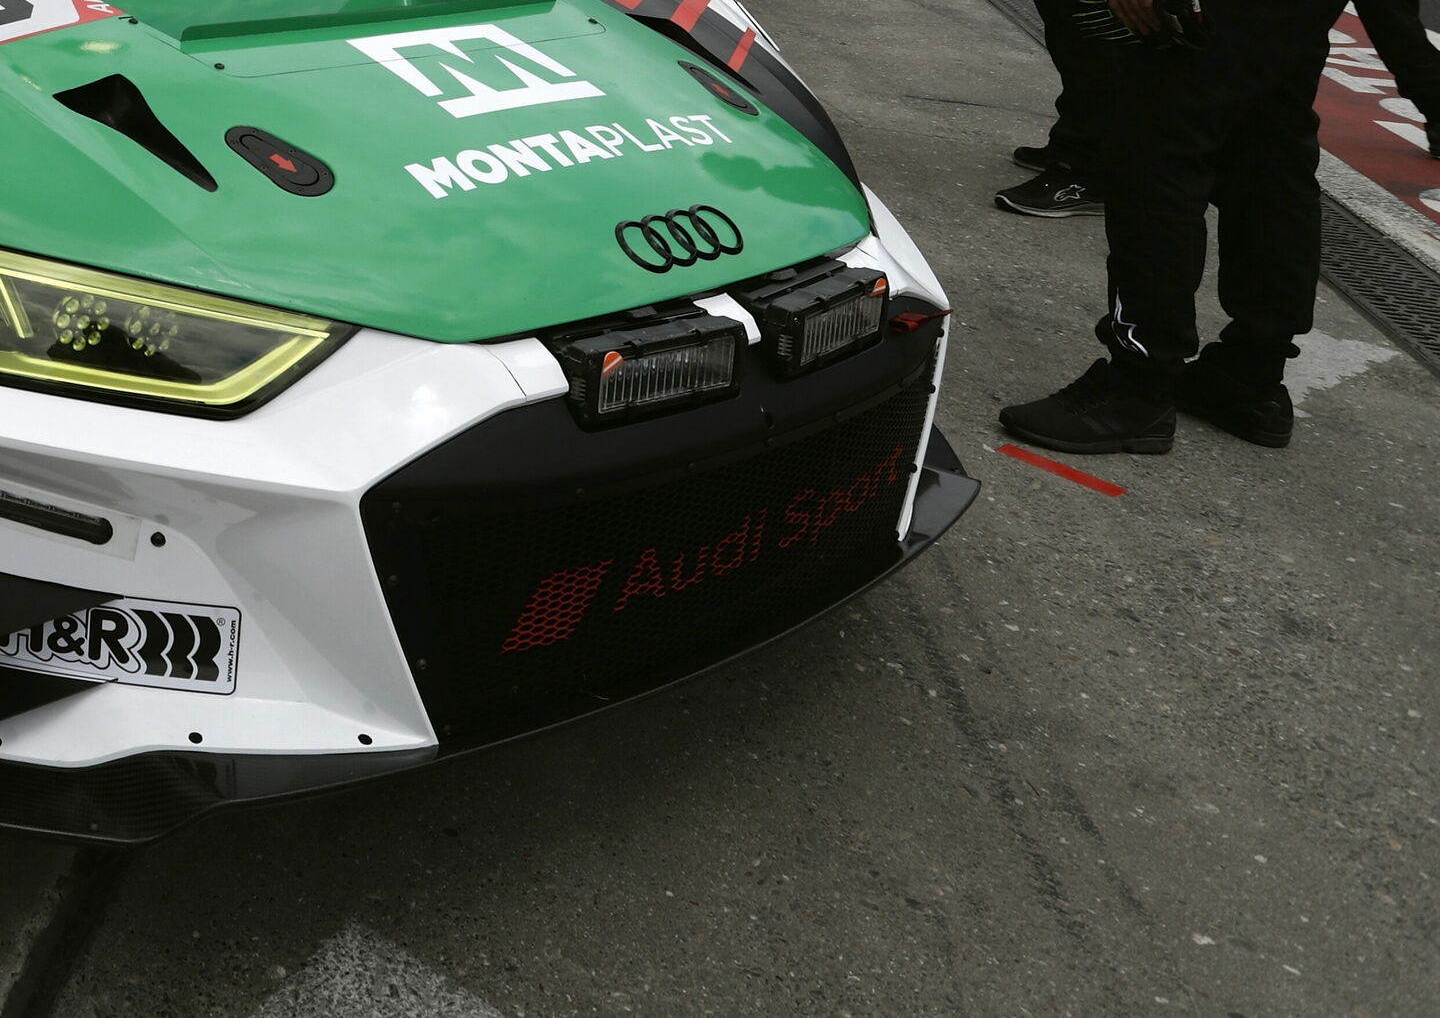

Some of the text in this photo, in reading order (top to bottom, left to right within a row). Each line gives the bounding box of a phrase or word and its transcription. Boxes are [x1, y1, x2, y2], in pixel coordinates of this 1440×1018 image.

[403, 114, 733, 200] MONTAPLAST
[614, 445, 904, 612] Audi Sport
[226, 620, 237, 683] www.h-r.com
